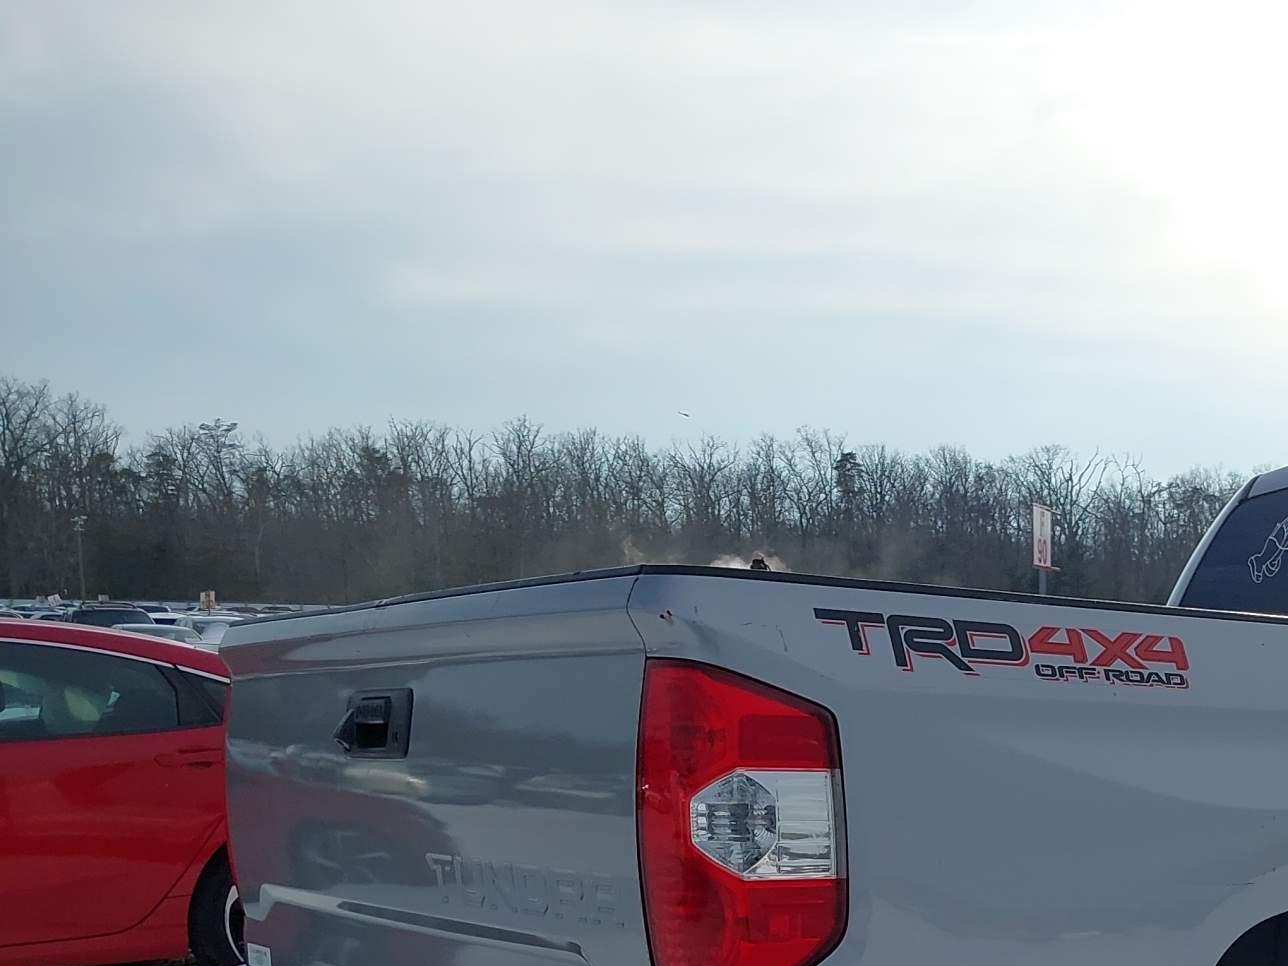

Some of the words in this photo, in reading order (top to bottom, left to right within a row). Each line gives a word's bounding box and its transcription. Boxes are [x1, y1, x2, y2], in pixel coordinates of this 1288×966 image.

[813, 608, 1029, 676] TRD
[1035, 663, 1101, 683] OFF
[1104, 668, 1190, 689] ROAD
